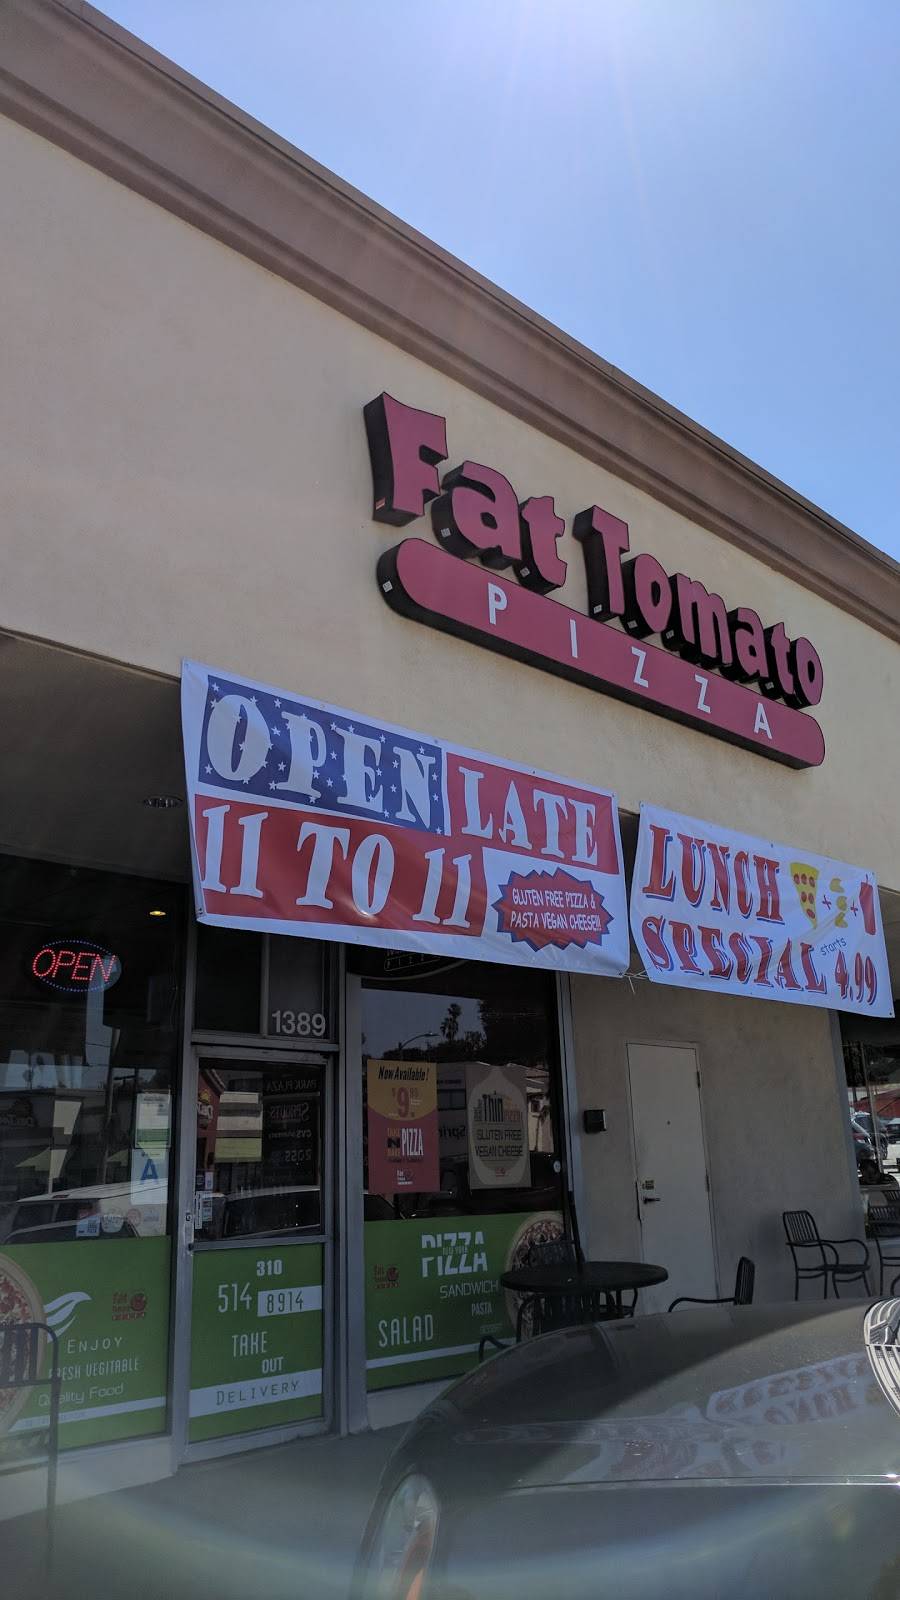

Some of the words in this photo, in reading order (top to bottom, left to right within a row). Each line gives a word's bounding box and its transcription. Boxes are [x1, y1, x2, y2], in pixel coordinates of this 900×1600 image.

[368, 391, 568, 590] Fat
[578, 505, 824, 707] Tomato
[487, 582, 774, 740] PIZZA
[206, 694, 436, 829] OPEN
[458, 766, 599, 865] LATE
[200, 804, 269, 899] 11
[295, 821, 395, 918] TO
[412, 847, 473, 929] 11
[642, 823, 785, 925] LUNCH
[512, 888, 545, 907] GLUTEN
[545, 890, 564, 908] FREE
[565, 892, 589, 910] PIZZA
[590, 893, 597, 910] &
[510, 910, 540, 929] PASTA
[541, 912, 569, 931] VEGAN
[820, 936, 847, 956] starts
[32, 949, 117, 983] OPEN
[641, 914, 828, 994] SPECIAL
[834, 949, 878, 1006] 4.99
[271, 1009, 327, 1036] 1389
[378, 1065, 394, 1081] Now
[401, 1127, 424, 1156] PIZZA
[503, 1129, 522, 1141] FREE
[140, 1158, 159, 1182] A
[421, 1230, 489, 1278] PIZZA
[256, 1259, 283, 1276] 310
[217, 1282, 252, 1313] 514
[266, 1289, 304, 1314] 8914
[439, 1280, 499, 1299] SANDWICH
[471, 1302, 493, 1317] PASTA
[378, 1314, 434, 1348] SALAD
[67, 1336, 123, 1354] ENJOY
[231, 1331, 268, 1358] TAKE
[86, 1358, 139, 1377] VEGITABLE
[261, 1356, 285, 1374] OUT
[89, 1382, 124, 1400] Food
[216, 1380, 301, 1406] DELIVERY
